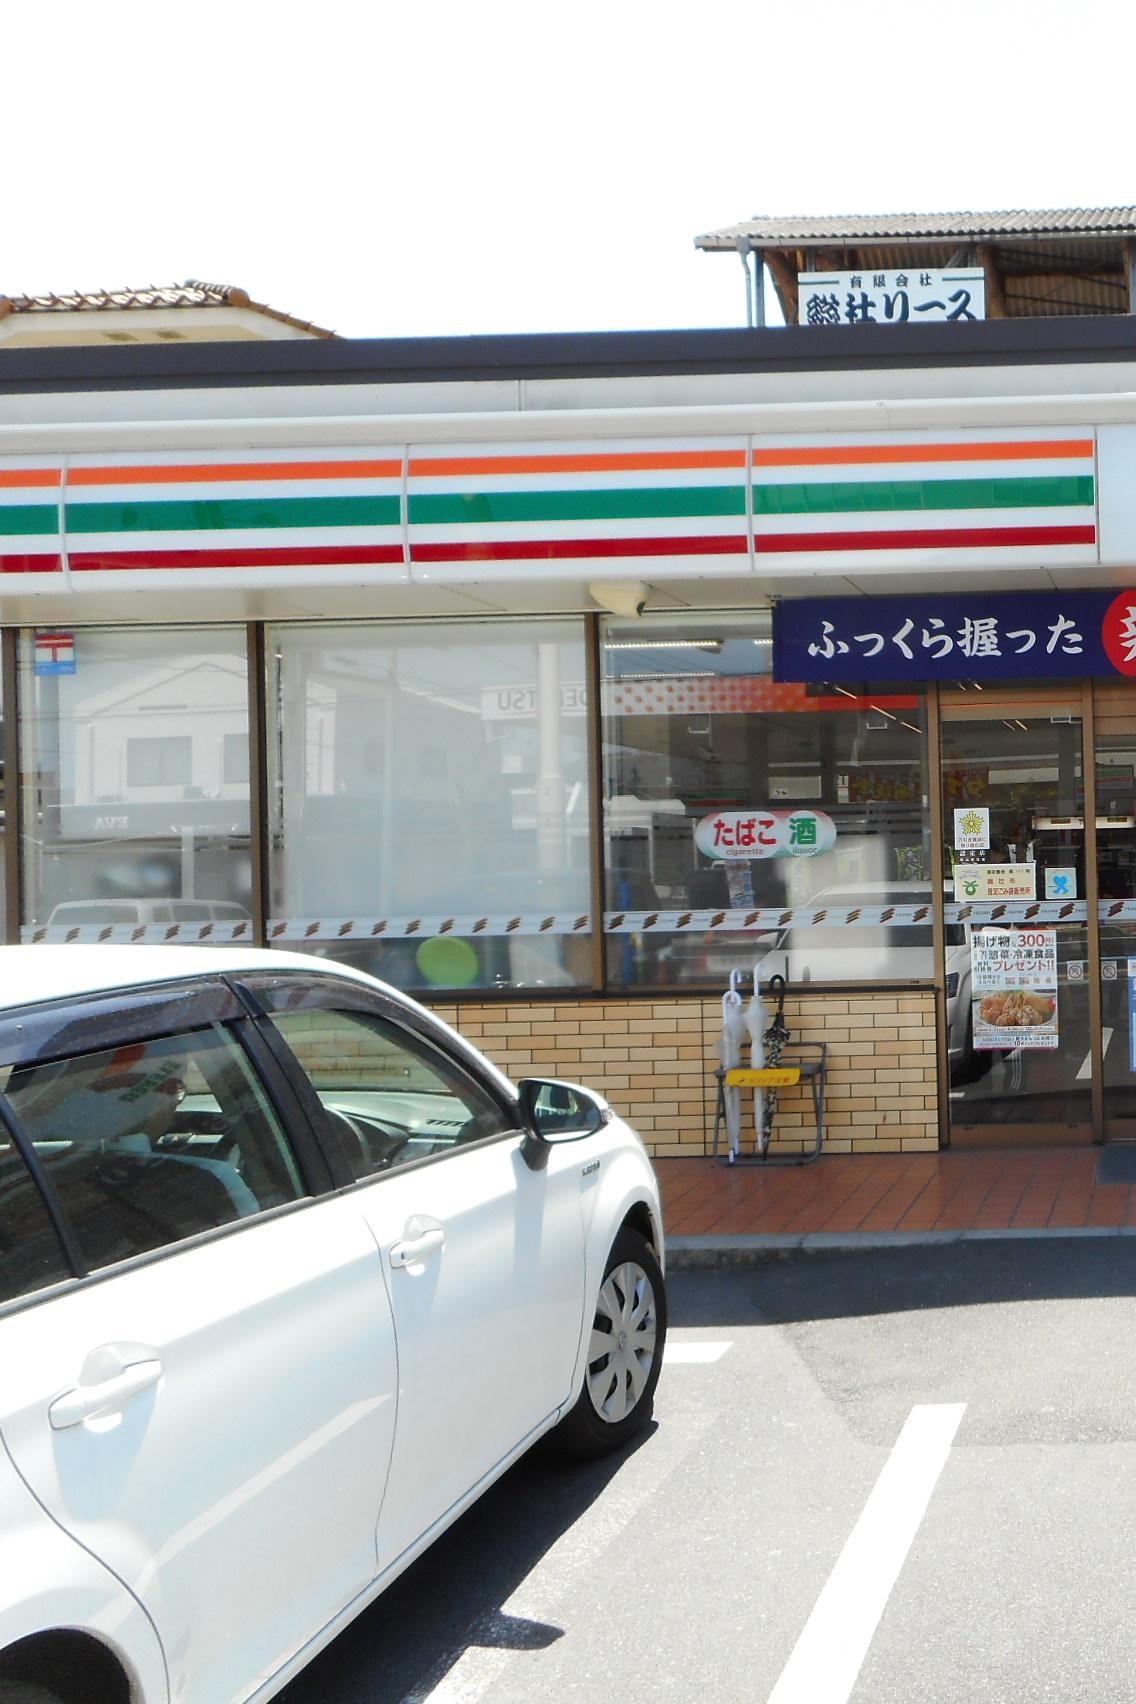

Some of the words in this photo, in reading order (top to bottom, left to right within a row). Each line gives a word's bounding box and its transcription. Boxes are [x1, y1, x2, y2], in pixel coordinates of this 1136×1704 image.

[850, 273, 932, 289] 有限会社
[807, 613, 1083, 660] ふっくら握った
[713, 816, 777, 847] たばこ
[789, 817, 817, 846] 酒
